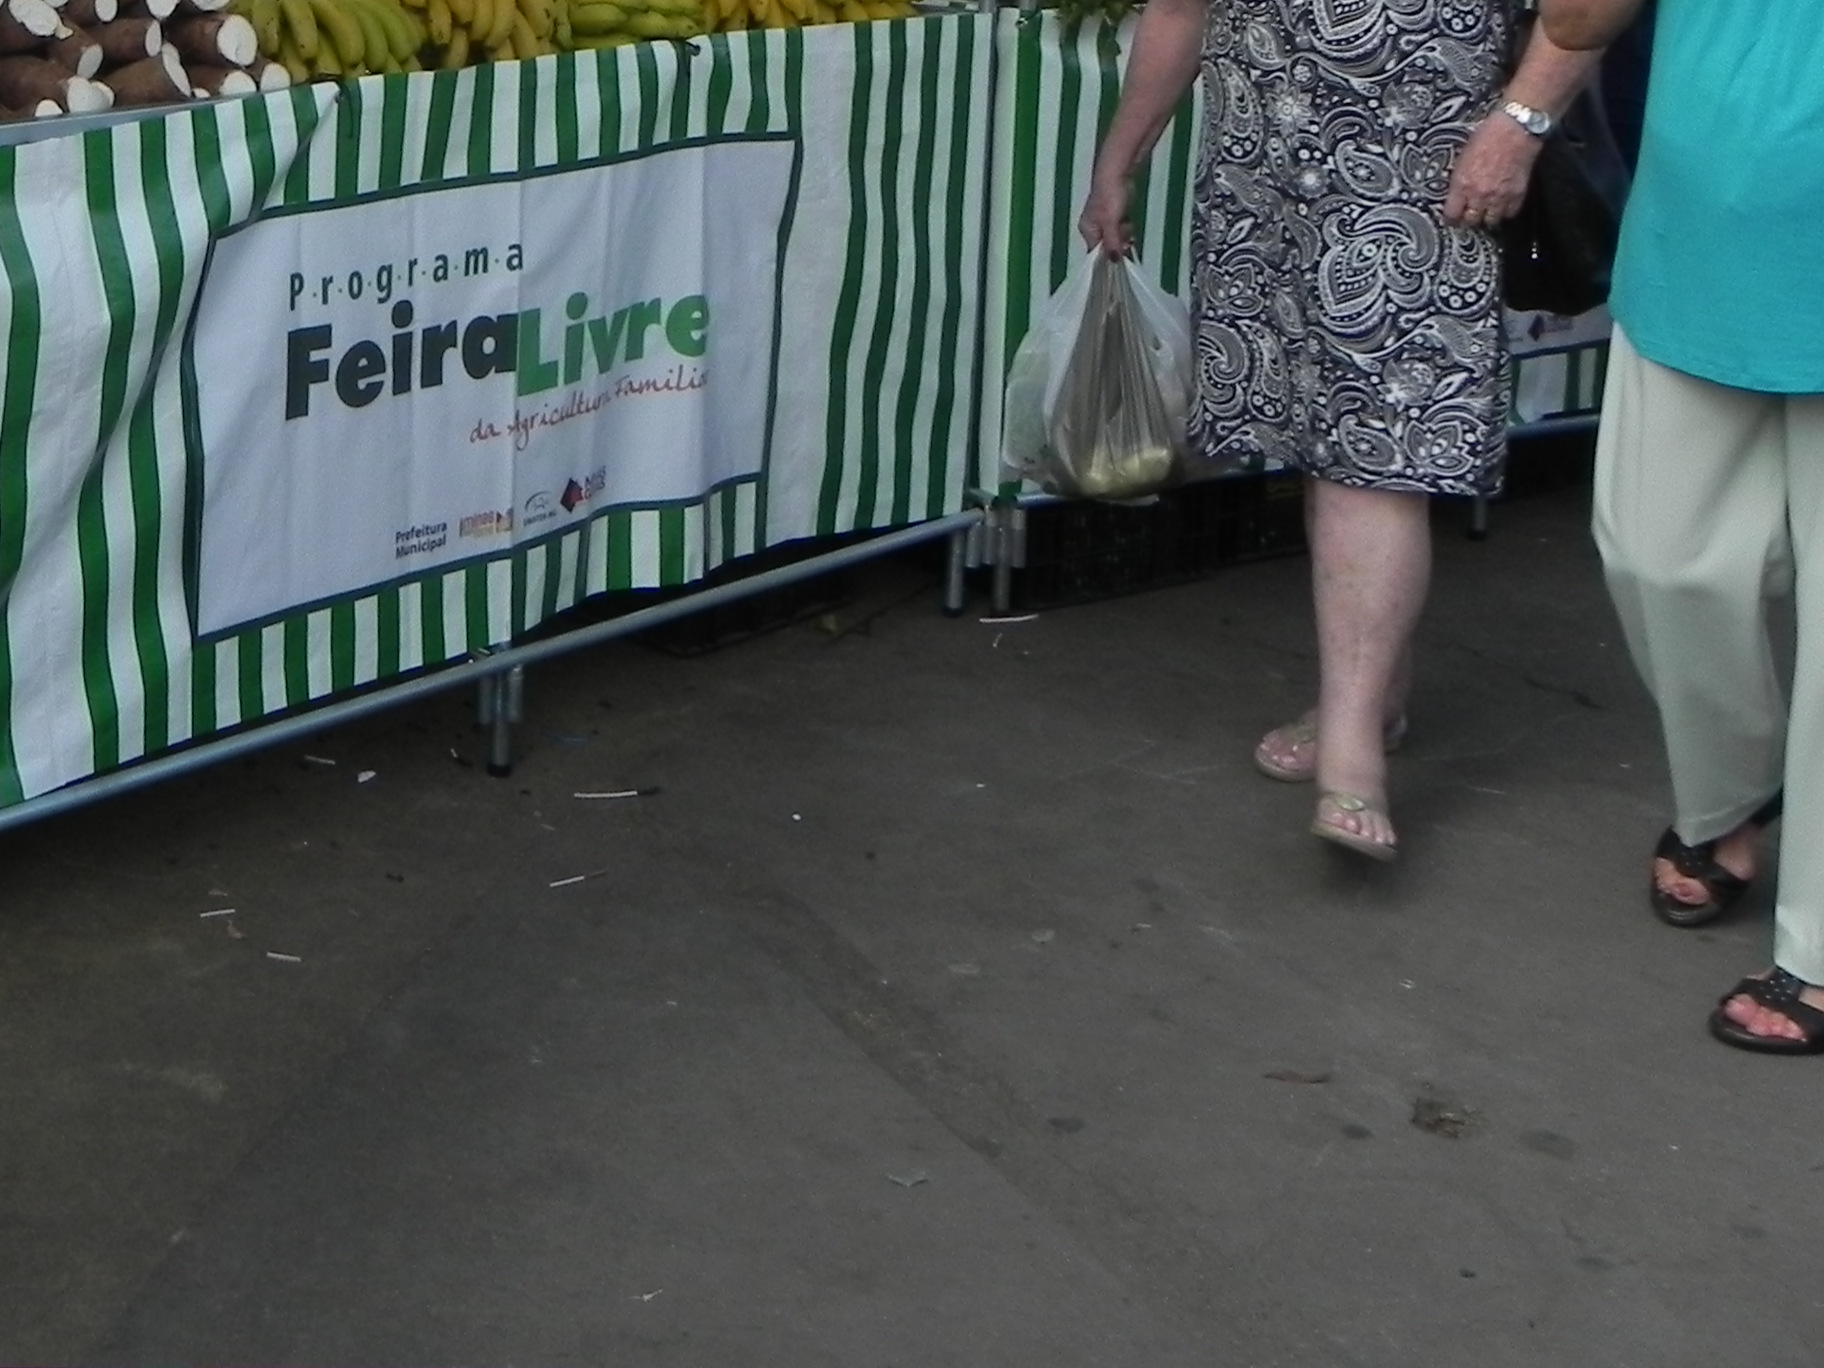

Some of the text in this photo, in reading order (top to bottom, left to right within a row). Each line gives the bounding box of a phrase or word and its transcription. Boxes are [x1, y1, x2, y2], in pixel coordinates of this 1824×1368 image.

[468, 417, 502, 444] da
[394, 521, 448, 545] Prefeitura
[395, 534, 447, 560] Municipal
